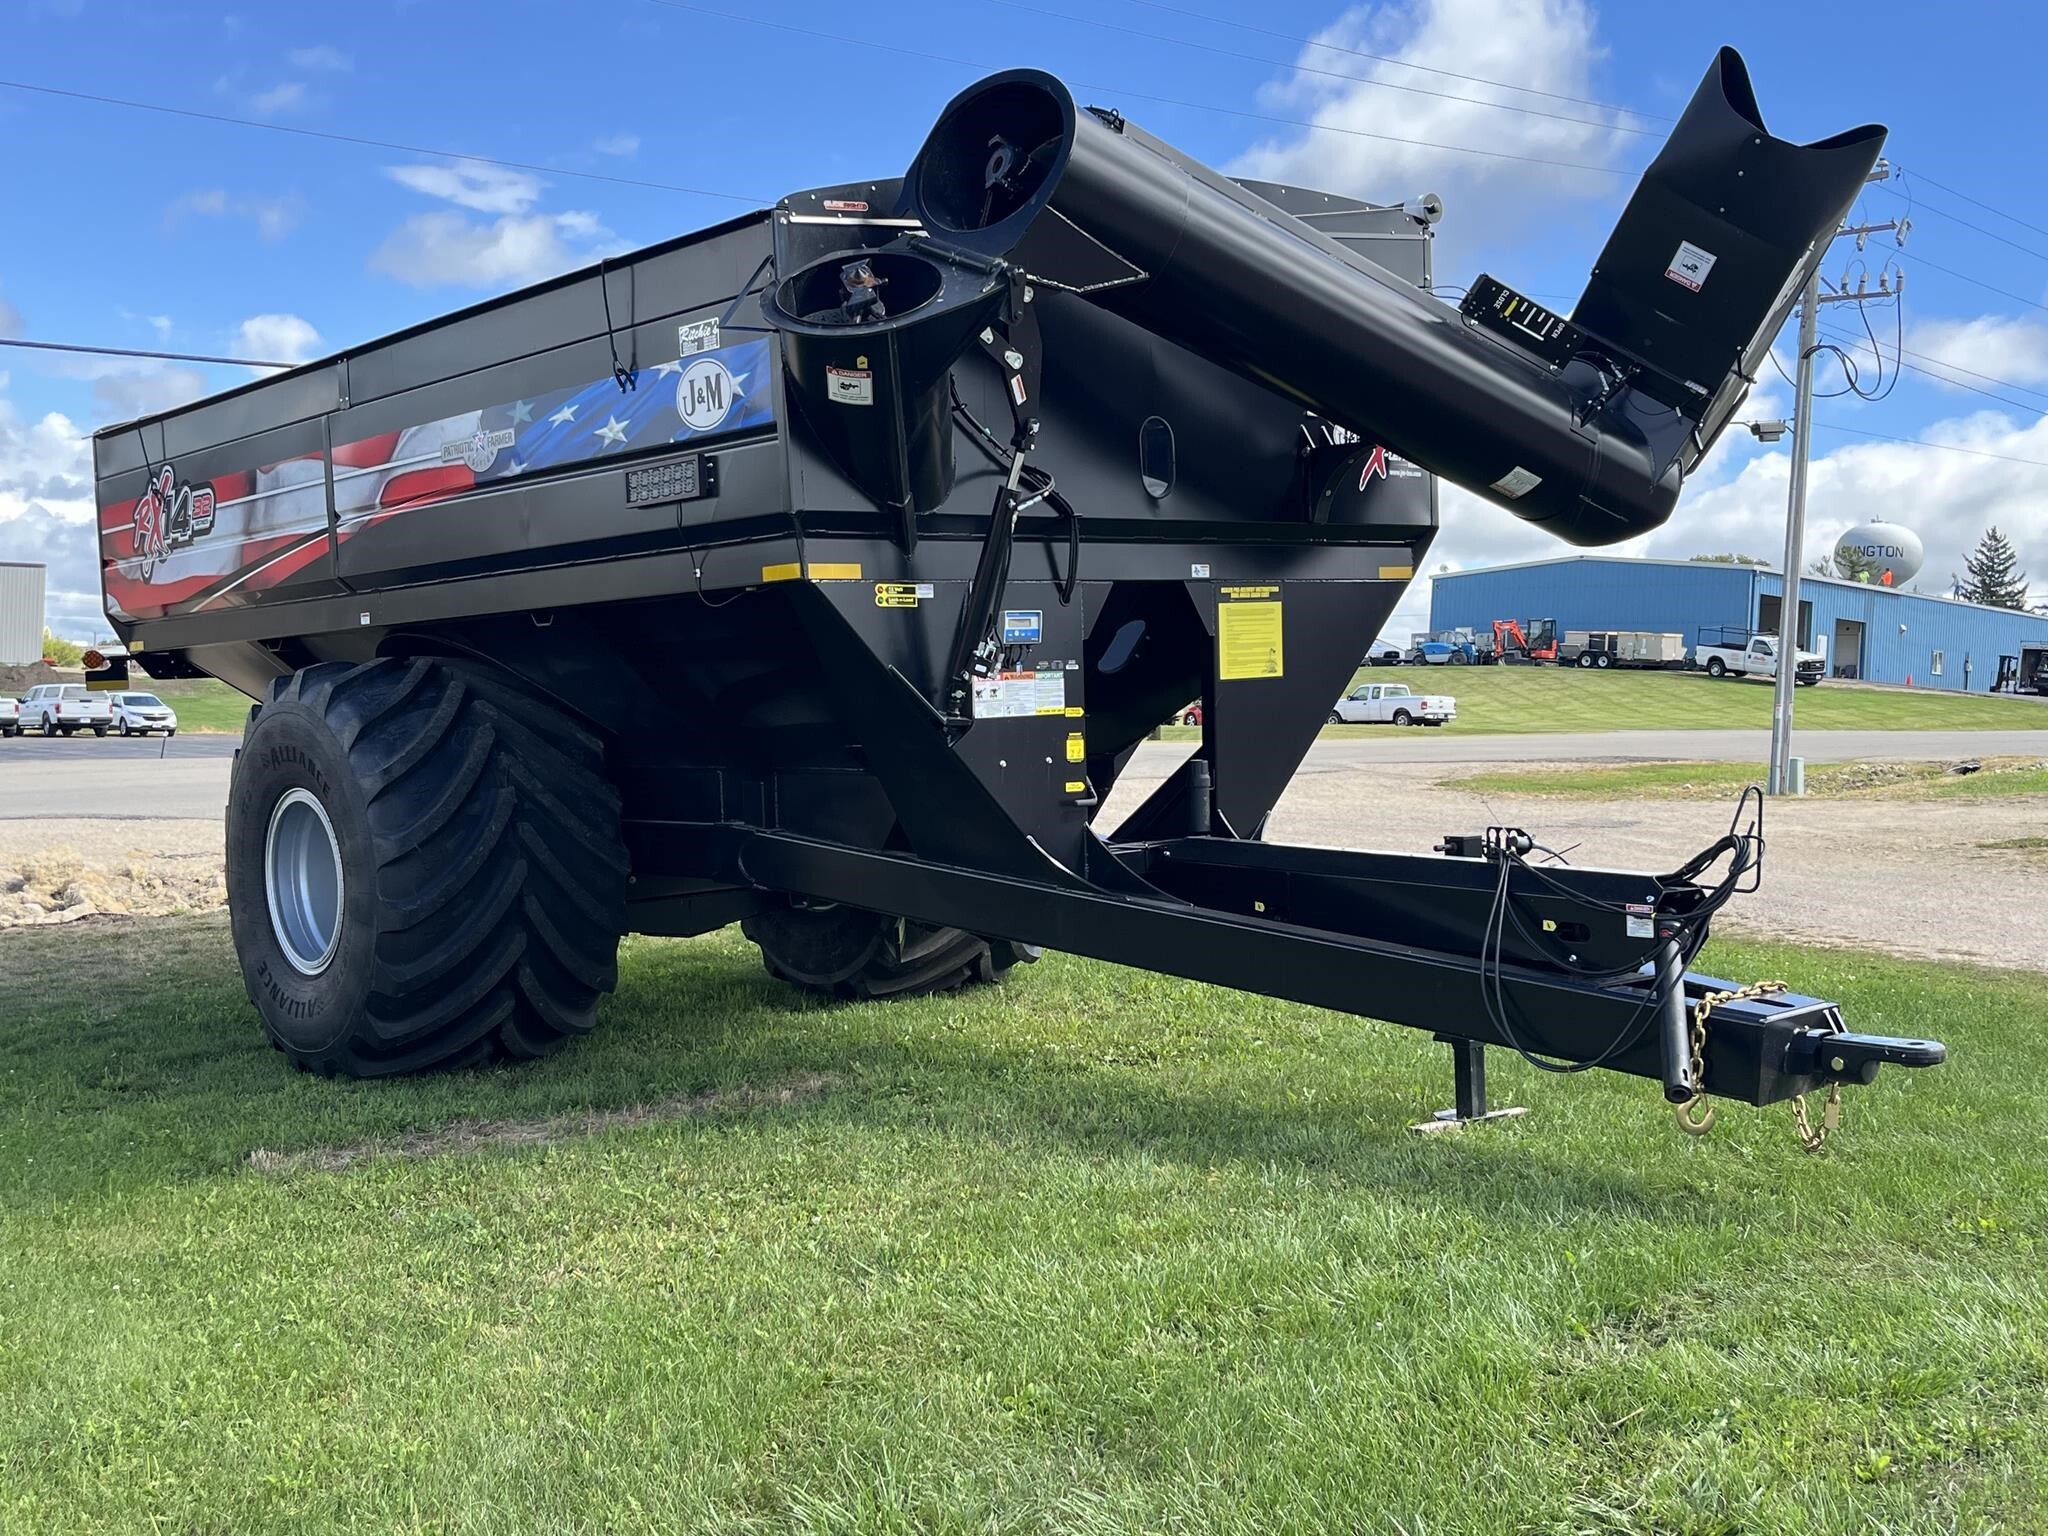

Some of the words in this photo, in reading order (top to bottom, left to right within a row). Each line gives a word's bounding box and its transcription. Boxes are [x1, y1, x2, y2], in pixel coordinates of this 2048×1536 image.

[1493, 289, 1510, 310] CLOSE
[680, 320, 718, 341] Ritchie's
[1551, 322, 1565, 339] OPEN
[682, 371, 724, 416] J&M
[443, 440, 474, 458] PATRIOTIC
[487, 431, 513, 448] FARMER
[271, 745, 331, 799] ALLIANCE
[256, 960, 317, 1019] ALLIANCE
